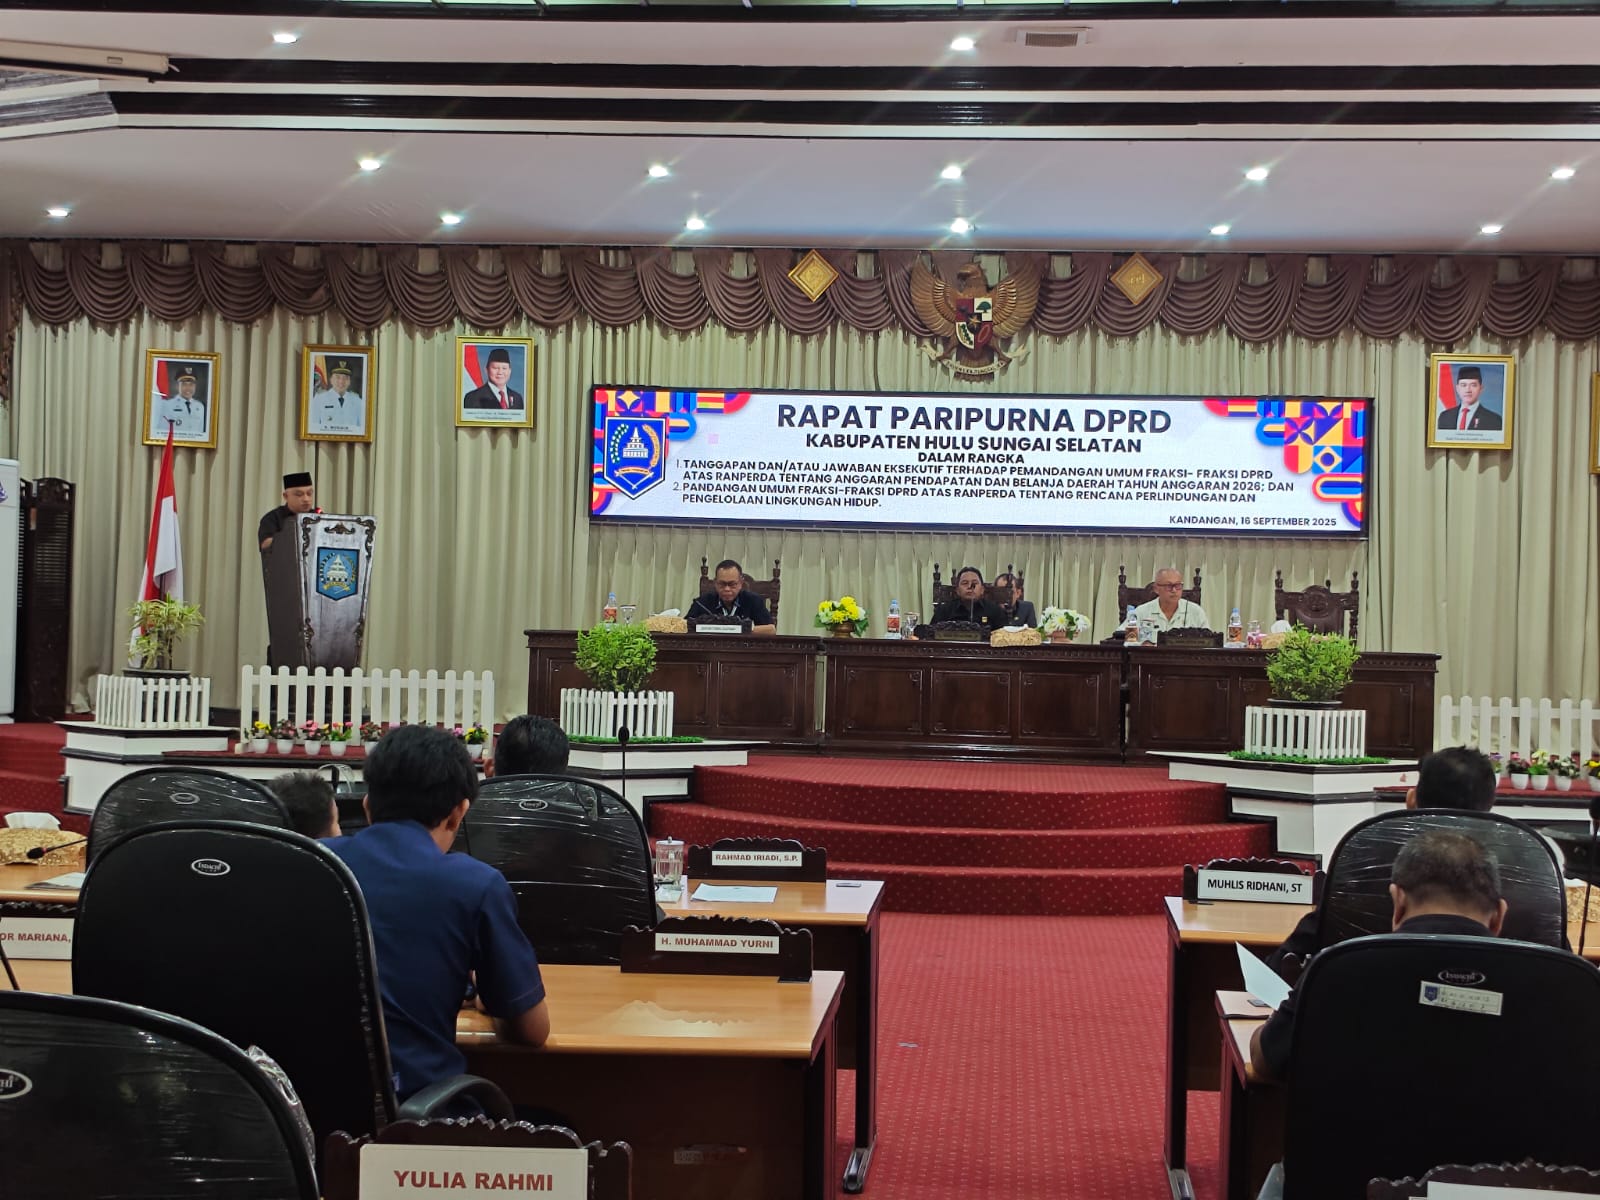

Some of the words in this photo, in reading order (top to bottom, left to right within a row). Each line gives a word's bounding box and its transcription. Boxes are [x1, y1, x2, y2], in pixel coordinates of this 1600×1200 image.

[778, 404, 883, 428] RAPAT
[891, 406, 1075, 432] PARIPURNA
[1084, 409, 1171, 433] DPRD
[806, 433, 920, 449] KABUPATEN
[925, 436, 974, 450] HULU
[978, 437, 1051, 451] SUNGAI
[1056, 438, 1141, 453] SELATAN
[918, 452, 965, 462] DALAM
[968, 453, 1025, 463] RANGKA
[683, 460, 755, 470] TANGGAPAN
[759, 460, 819, 472] DAN/ATAU
[822, 463, 881, 472] JAWABAN
[884, 464, 944, 474] EKSEKUTIF
[947, 465, 1007, 475] TERHADAP
[1010, 467, 1102, 476] PEMANDANGAN
[1106, 468, 1143, 477] UMUM
[1197, 470, 1238, 479] FRAKSI
[1241, 470, 1273, 479] DPRD
[683, 471, 713, 480] ATAS
[716, 472, 776, 482] RANPERDA
[780, 473, 832, 483] TENTANG
[835, 475, 901, 484] ANGGARAN
[905, 476, 982, 486] PENDAPATAN
[985, 477, 1010, 486] DAN
[1013, 478, 1064, 487] BELANJA
[1067, 479, 1115, 489] DAERAH
[1118, 480, 1158, 489] TAHUN
[1161, 481, 1230, 490] ANGGARAN
[1232, 481, 1264, 491] 2026;
[1268, 482, 1294, 491] DAN
[682, 494, 763, 504] PENGELOLAAN
[765, 496, 841, 506] LINGKUNGAN
[844, 497, 882, 507] HIDUP.
[683, 483, 756, 493] PANDANGAN
[759, 484, 795, 493] UMUM
[799, 485, 885, 495] FRAKSI-FRAKSI
[888, 488, 918, 496] DPRD
[921, 488, 951, 497] ATAS
[954, 489, 1016, 498] RANPERDA
[1020, 490, 1073, 499] TENTANG
[1076, 491, 1133, 500] RENCANA
[1136, 492, 1227, 502] PERLINDUNGAN
[1230, 493, 1256, 502] DAN
[1170, 516, 1238, 525] KANDANGAN,
[1241, 517, 1250, 525] 16
[1253, 517, 1310, 526] SEPTEMBER
[1312, 518, 1337, 526] 2025
[1207, 879, 1244, 890] MUHLIS
[1246, 881, 1289, 893] RIDHANI,
[1291, 883, 1303, 892] ST
[18, 933, 71, 943] MARIANA,
[675, 938, 737, 947] MUHAMMAD
[740, 940, 773, 948] YURNI
[394, 1170, 466, 1188] YULIA
[475, 1173, 553, 1191] RAHMI
